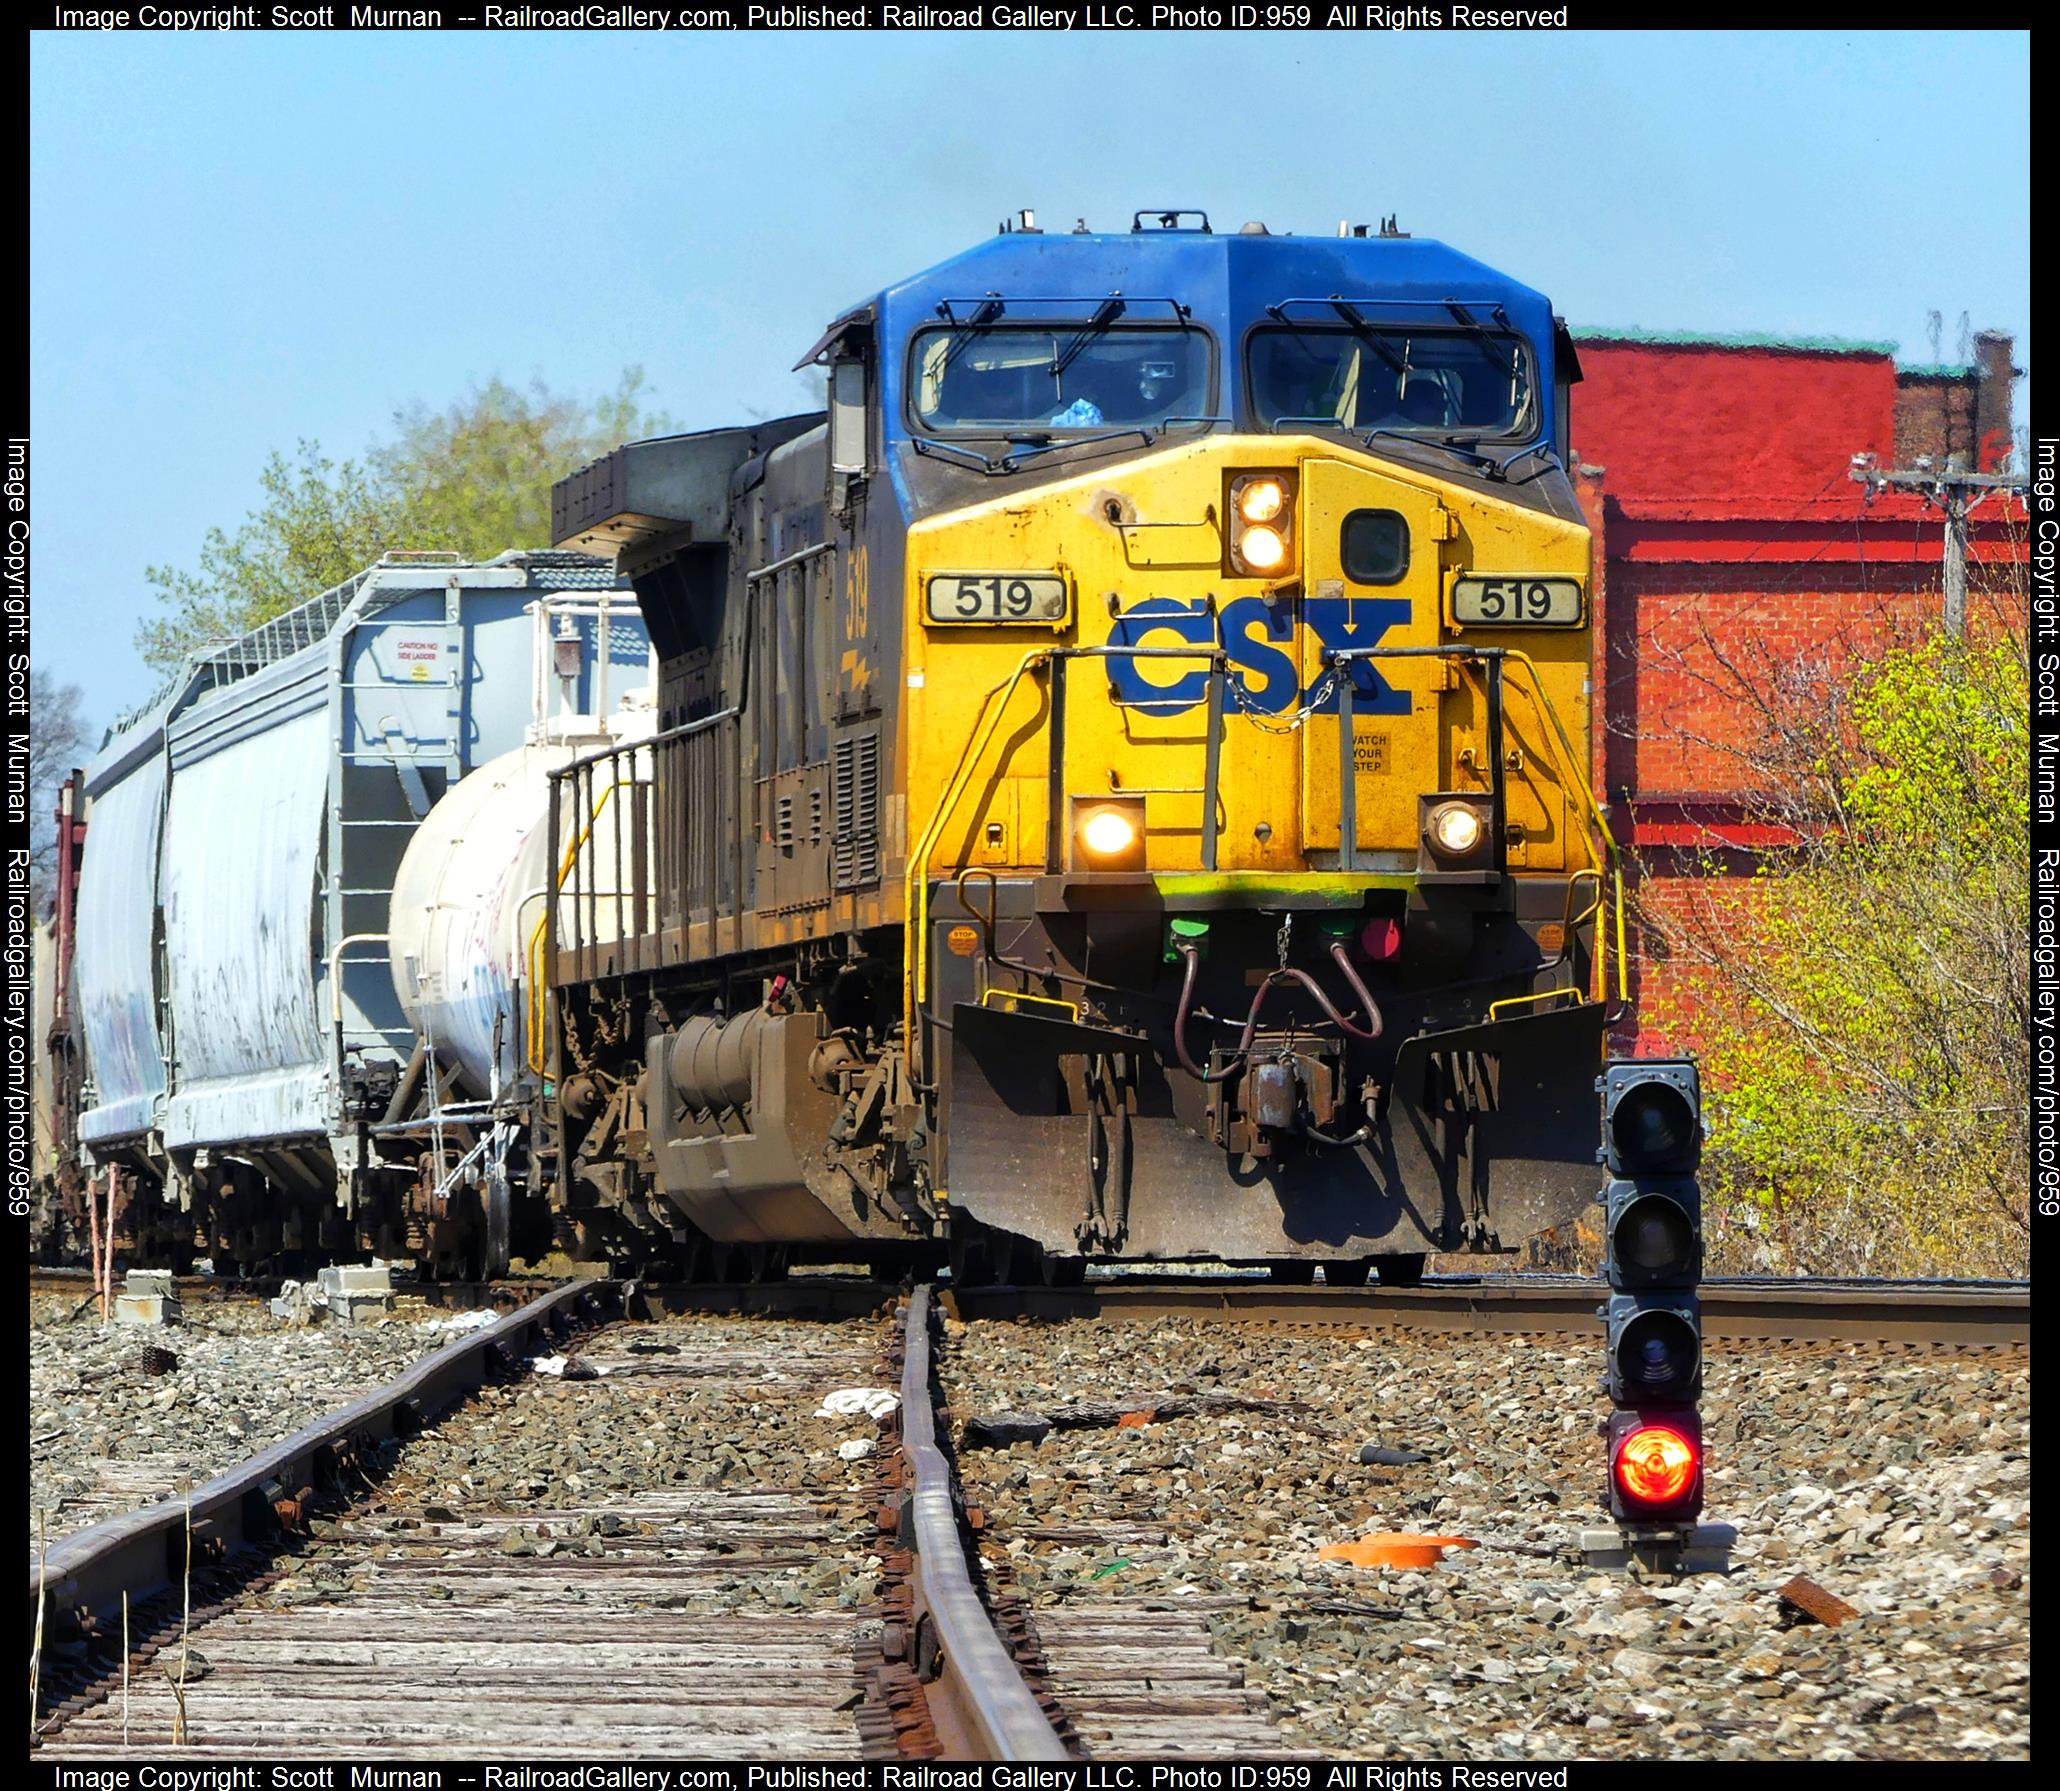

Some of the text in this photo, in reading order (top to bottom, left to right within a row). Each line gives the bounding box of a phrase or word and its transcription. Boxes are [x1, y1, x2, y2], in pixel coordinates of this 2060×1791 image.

[847, 544, 868, 641] 519
[955, 579, 1032, 616] 519
[1480, 581, 1551, 619] 519
[1106, 597, 1412, 717] CSX
[1353, 748, 1382, 758] YOUR
[1354, 762, 1381, 771] STEP
